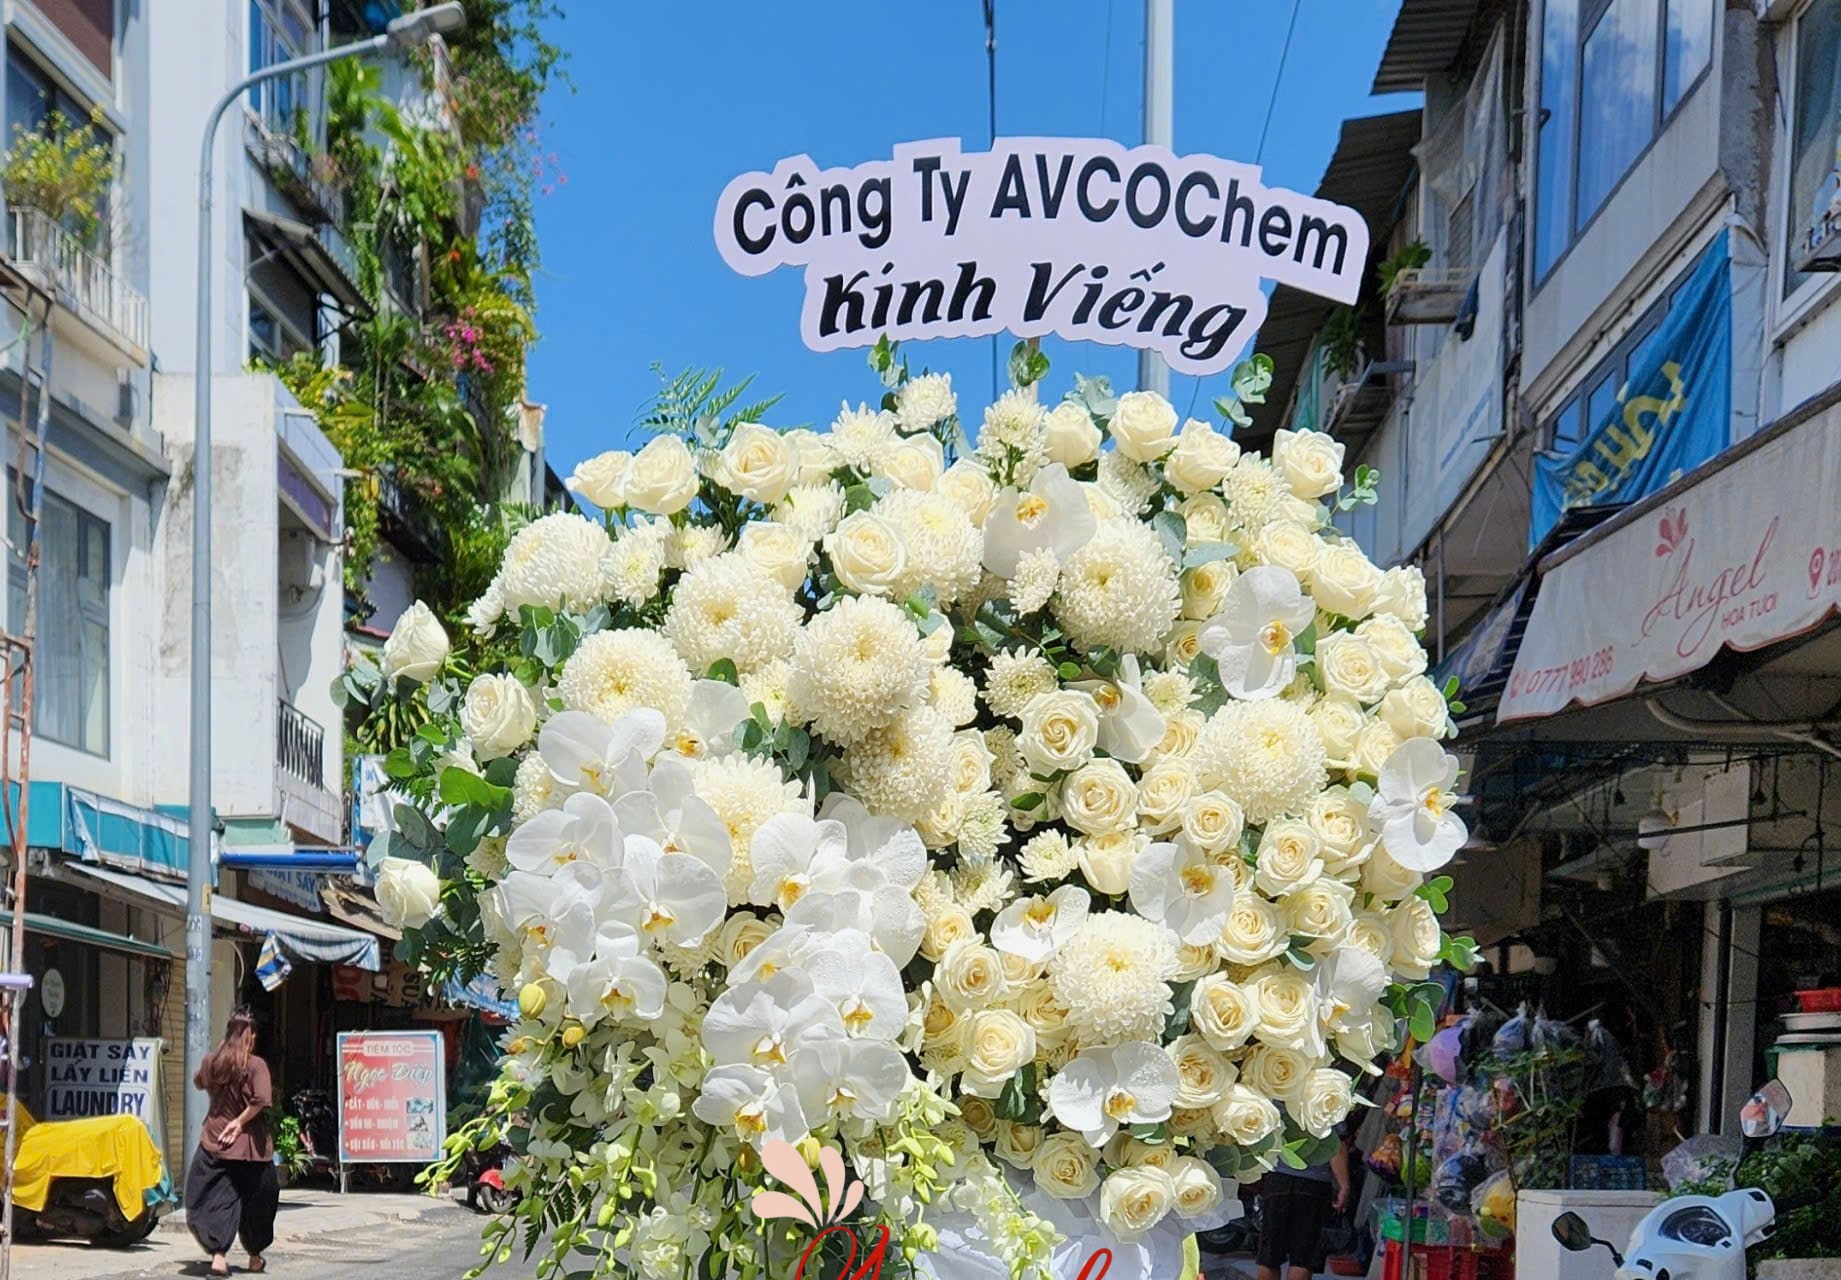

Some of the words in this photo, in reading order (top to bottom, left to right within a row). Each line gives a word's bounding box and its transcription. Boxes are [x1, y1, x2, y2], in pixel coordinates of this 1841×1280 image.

[732, 173, 893, 254] Công
[912, 155, 972, 236] Ty
[990, 153, 1350, 276] AVCOChem
[818, 260, 998, 337] Kính
[1022, 260, 1247, 361] Viếng
[1631, 515, 1779, 658] Angel
[51, 1089, 145, 1116] LAUNDRY
